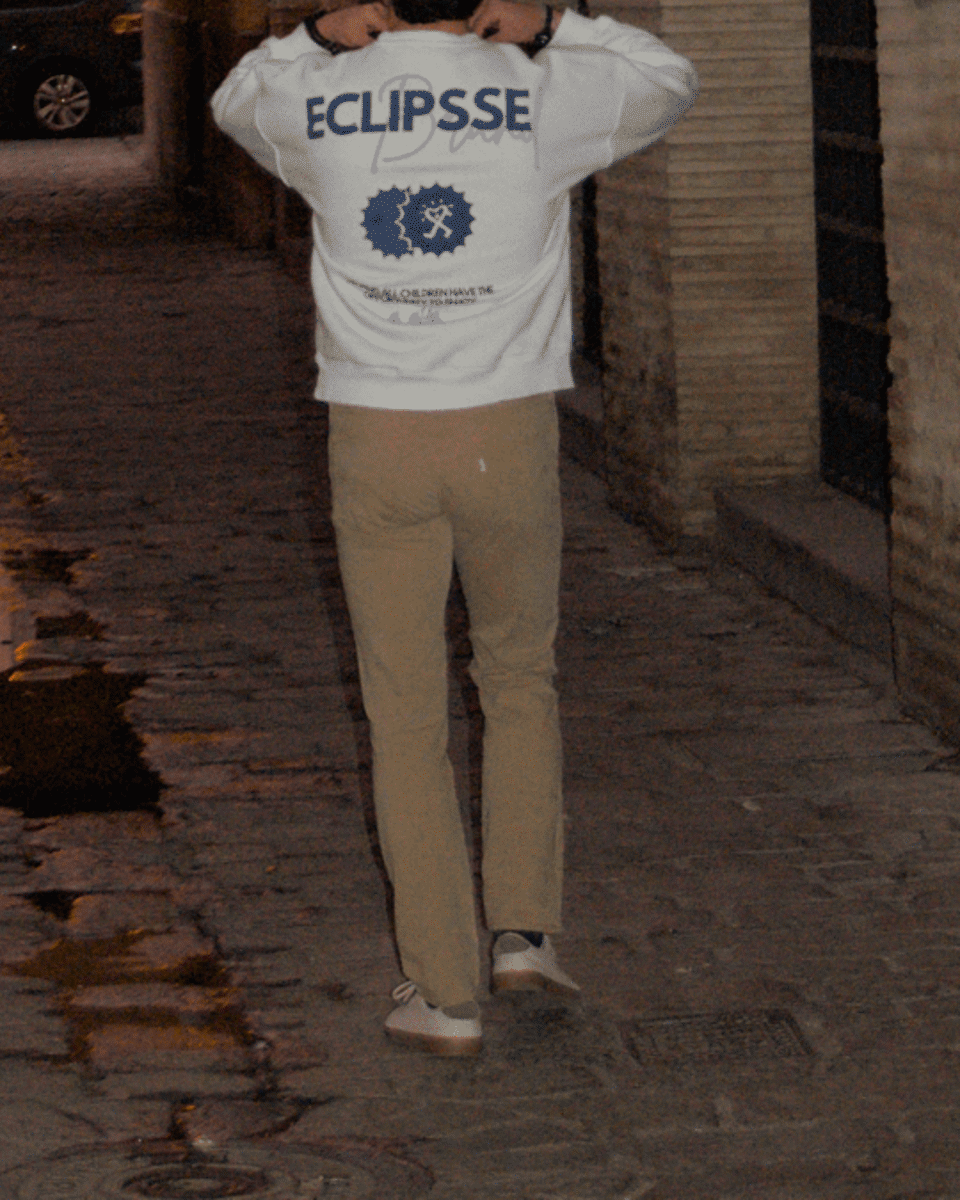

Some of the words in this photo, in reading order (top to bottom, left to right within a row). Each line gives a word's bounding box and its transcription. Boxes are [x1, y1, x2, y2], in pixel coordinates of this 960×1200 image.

[306, 87, 533, 141] ECLIPSSE
[400, 287, 448, 298] CHILDREN
[449, 286, 476, 297] HAVE
